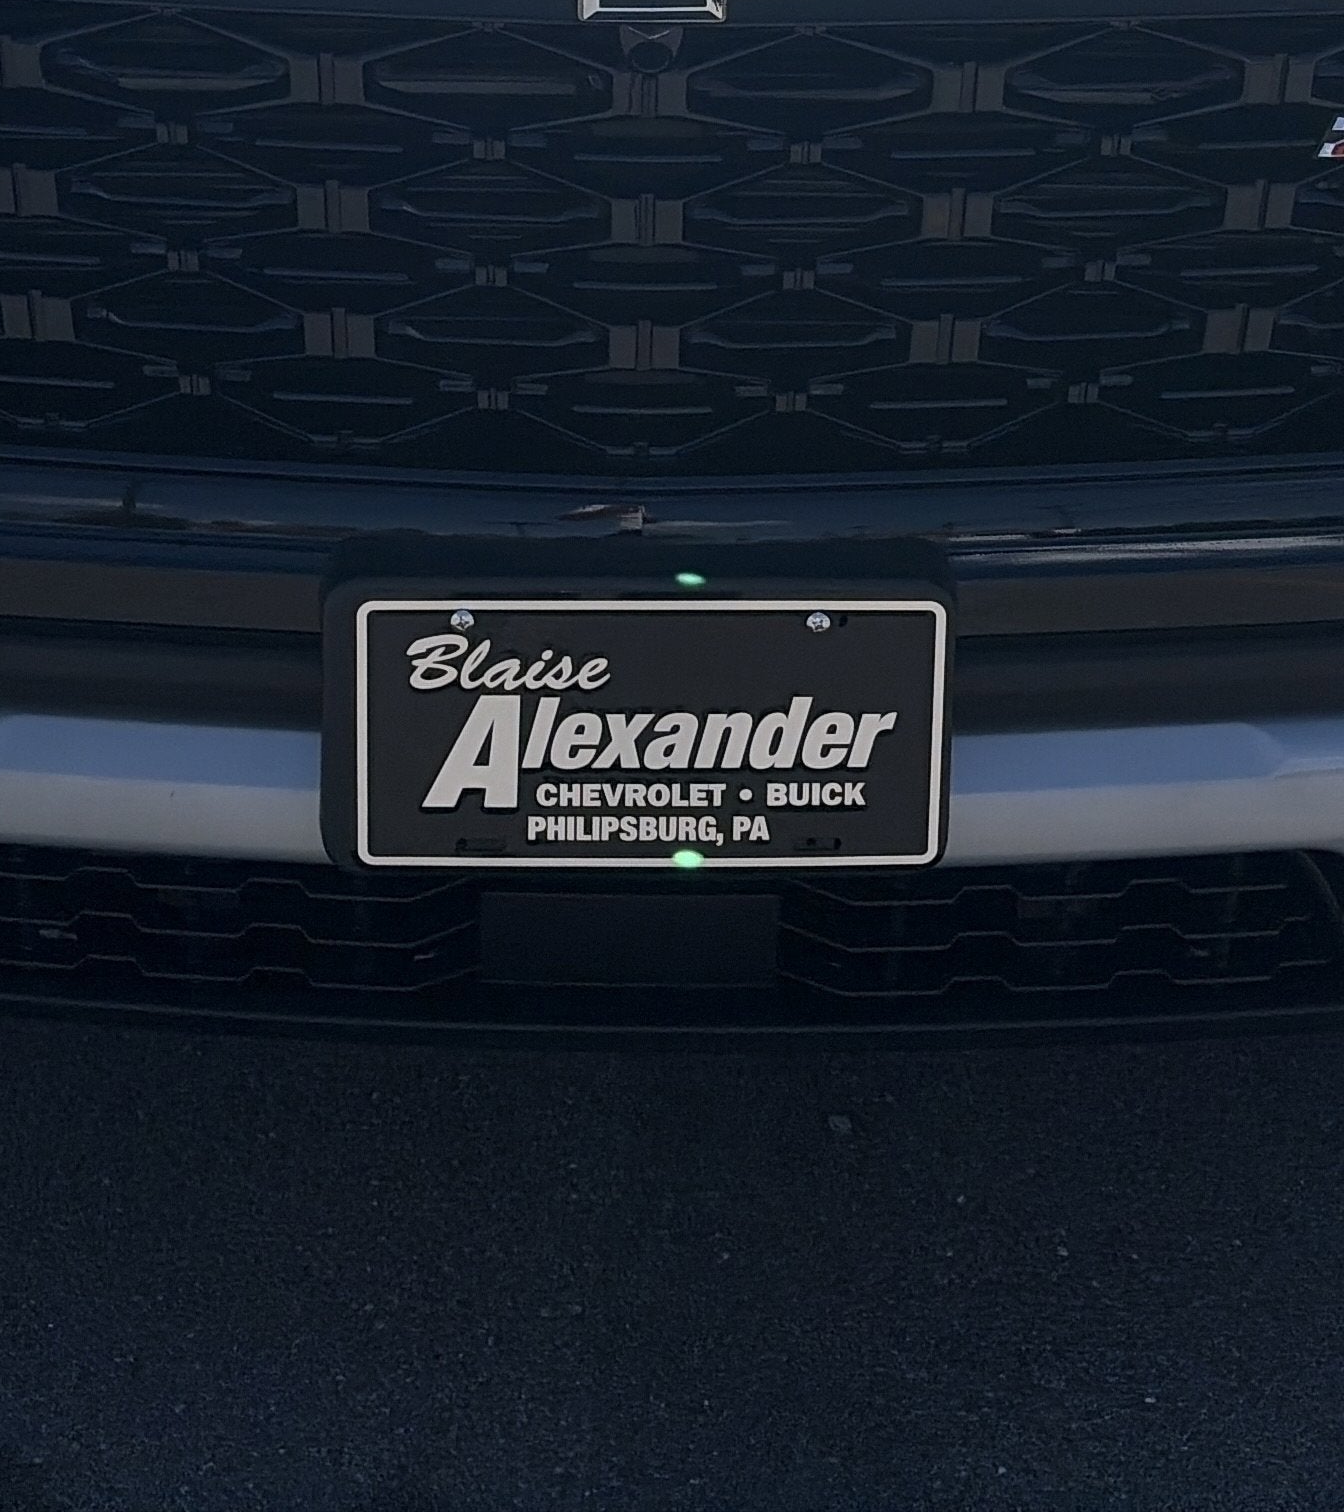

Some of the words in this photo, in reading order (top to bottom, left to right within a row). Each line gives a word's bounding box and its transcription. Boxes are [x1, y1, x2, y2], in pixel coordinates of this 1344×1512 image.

[406, 634, 611, 690] Blaise
[421, 694, 898, 808] Alexander
[536, 782, 727, 807] CHEVROLET
[766, 782, 866, 807] BUICK
[527, 815, 724, 847] PHILIPSBURG,
[732, 815, 770, 842] PA
